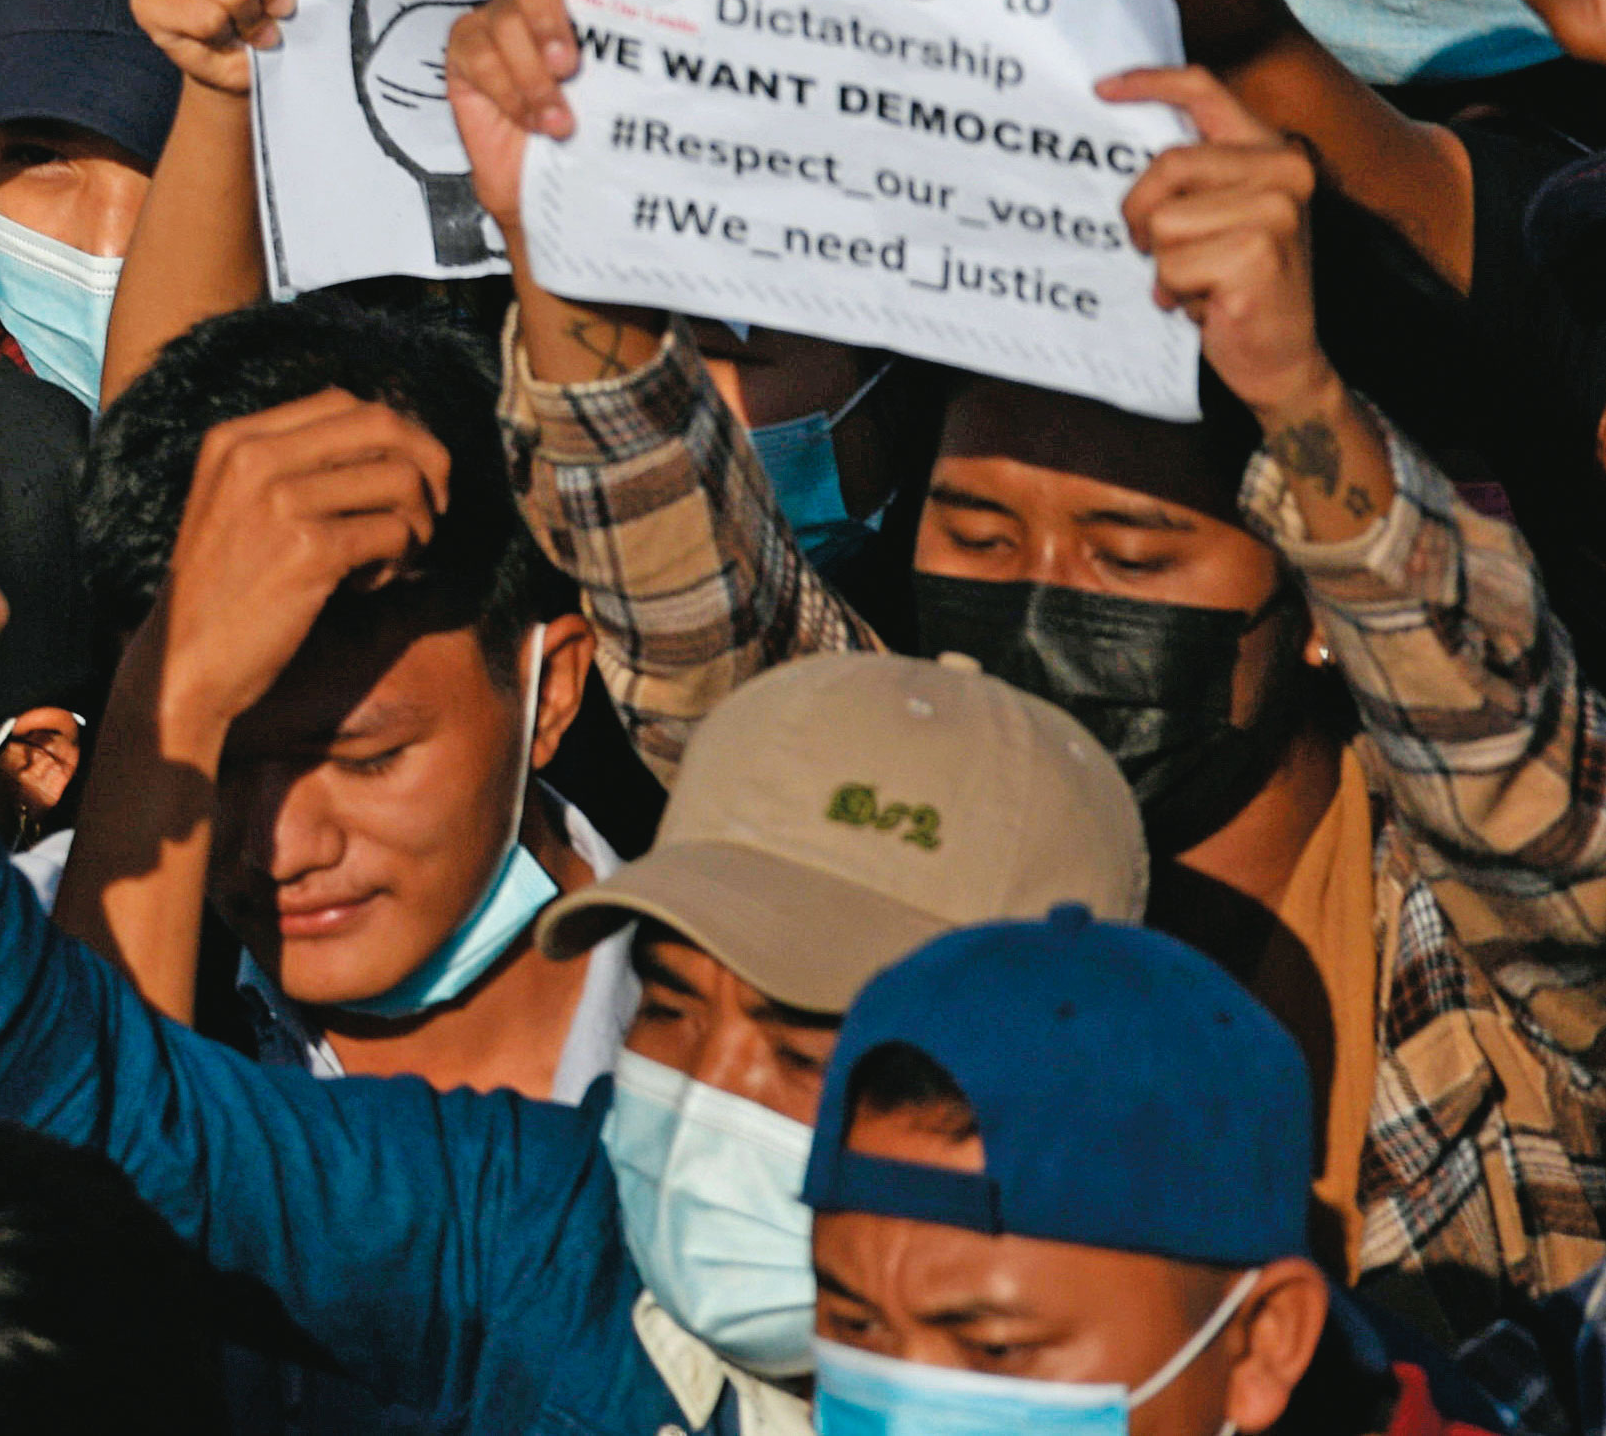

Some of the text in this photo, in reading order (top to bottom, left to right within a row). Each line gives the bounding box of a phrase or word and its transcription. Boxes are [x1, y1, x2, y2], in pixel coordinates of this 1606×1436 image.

[661, 49, 816, 108] WANT
[611, 115, 1123, 251] #Respect_our_votes
[633, 196, 1101, 318] #We_need_justice
